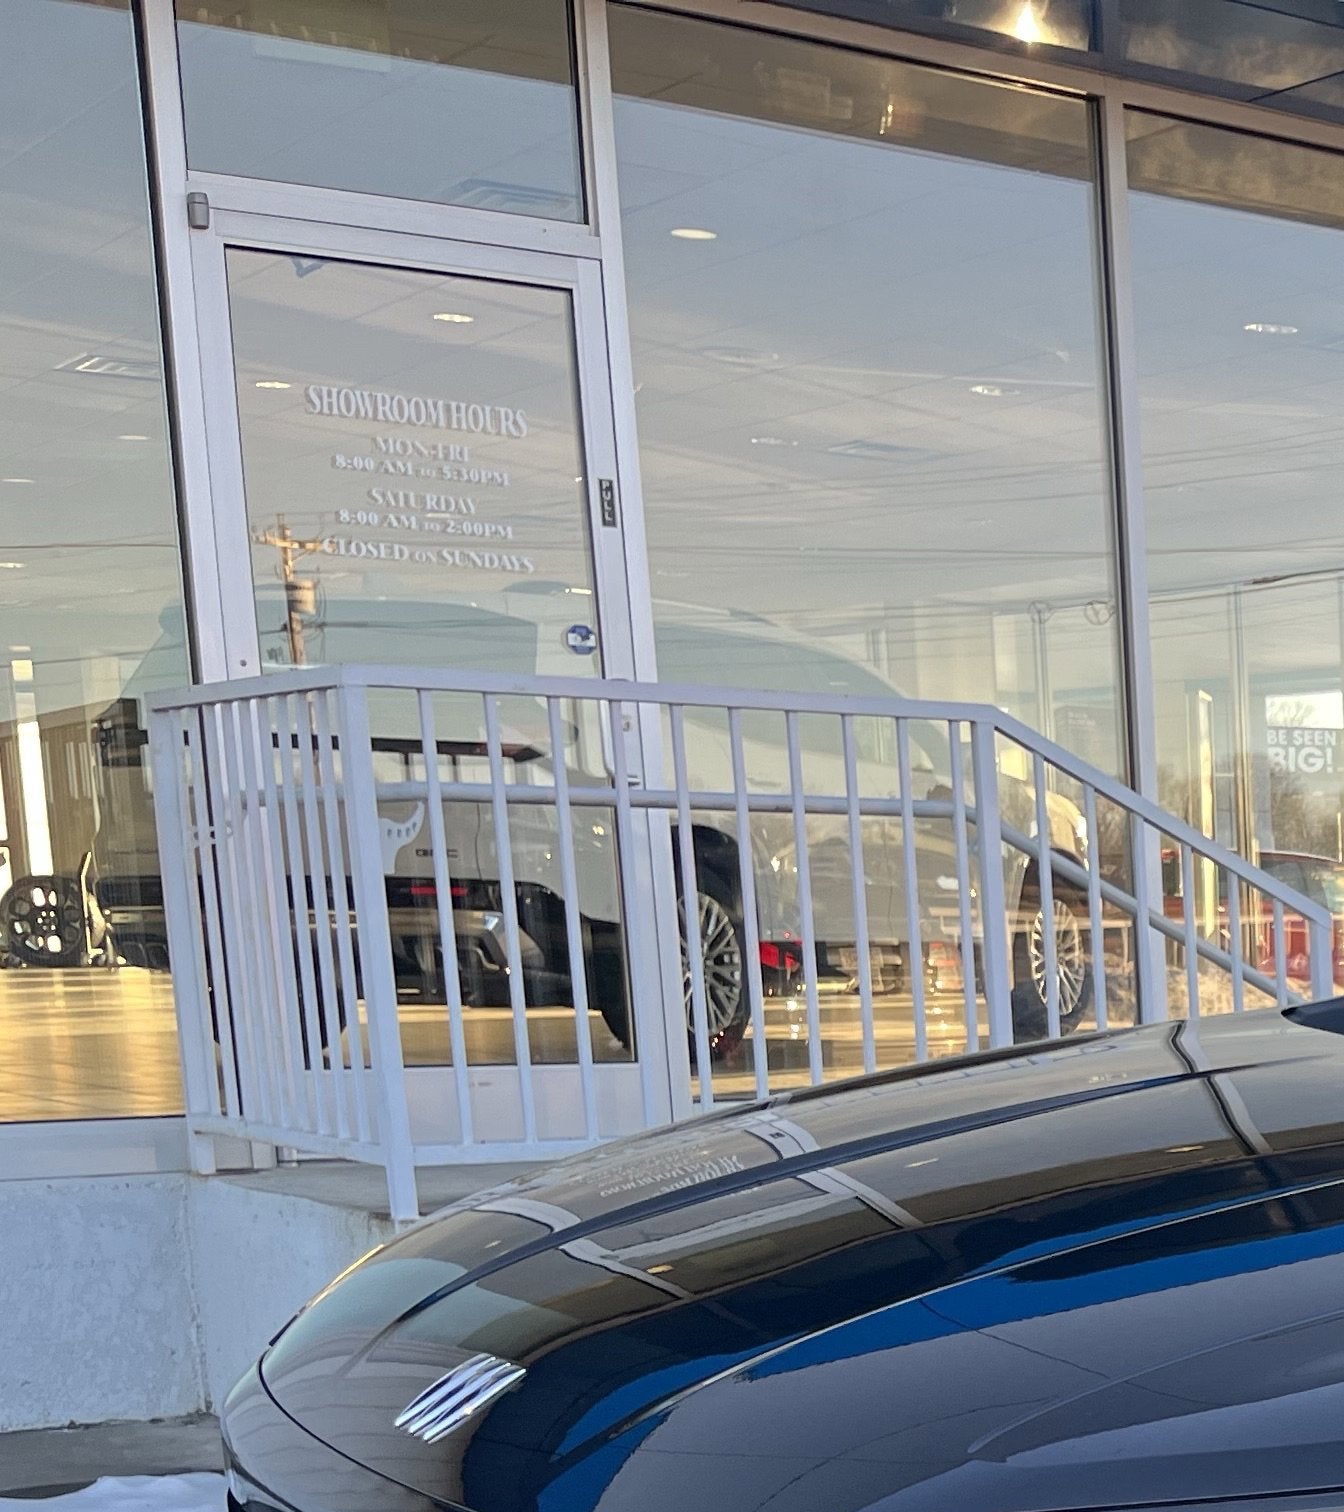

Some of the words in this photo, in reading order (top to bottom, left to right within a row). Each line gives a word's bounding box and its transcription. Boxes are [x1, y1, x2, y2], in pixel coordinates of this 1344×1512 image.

[308, 384, 445, 428] SHOWROOM
[450, 402, 528, 438] HOURS
[374, 437, 470, 463] MON-FRI
[334, 455, 375, 471] 8:00
[380, 460, 413, 476] AM
[441, 465, 511, 486] 5:30PM
[370, 488, 477, 515] SATURDAY
[601, 480, 614, 522] PULL
[338, 509, 379, 525] 8:00
[383, 513, 418, 530] AM
[445, 519, 514, 540] 2:00PM
[322, 537, 410, 561] CLOSED
[441, 549, 535, 574] SUNDAYS
[1267, 730, 1288, 745] BE
[1293, 730, 1337, 746] SEEN
[1267, 747, 1334, 774] BIG!
